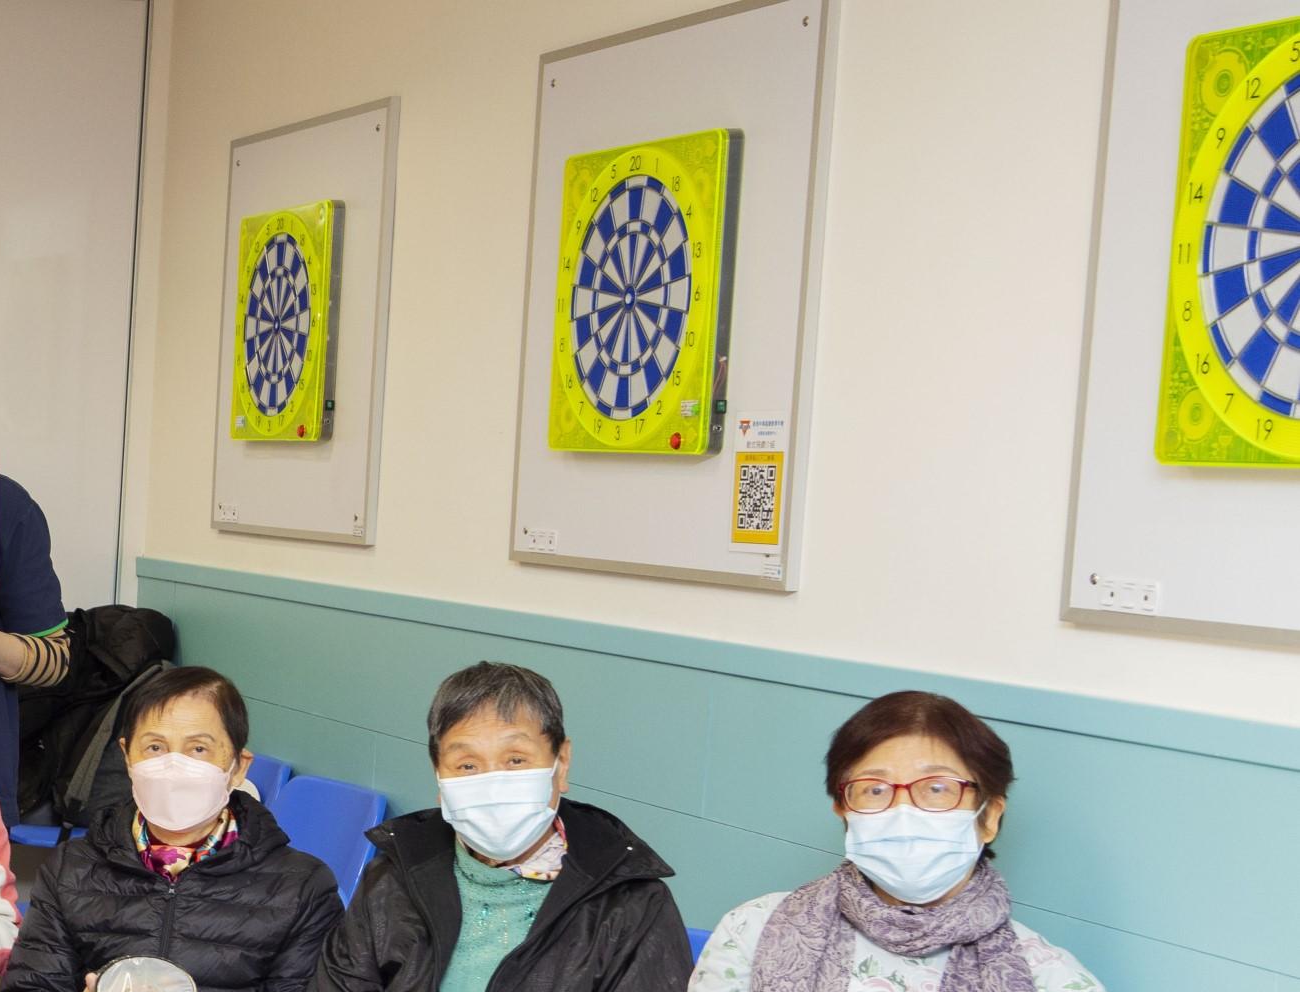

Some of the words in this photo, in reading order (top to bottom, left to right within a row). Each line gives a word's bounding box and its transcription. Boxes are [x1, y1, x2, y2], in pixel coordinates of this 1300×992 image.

[1246, 77, 1261, 100] 12
[1216, 128, 1226, 149] 9
[610, 164, 617, 179] 5
[629, 155, 641, 172] 20
[671, 176, 680, 192] 18
[590, 187, 599, 202] 12
[1189, 182, 1202, 204] 14
[685, 203, 692, 219] 4
[576, 220, 582, 234] 9
[692, 241, 702, 258] 13
[1178, 243, 1191, 264] 11
[563, 256, 571, 272] 14
[694, 283, 700, 302] 6
[557, 298, 565, 314] 11
[1182, 301, 1192, 321] 8
[685, 331, 696, 347] 10
[1197, 353, 1210, 374] 16
[565, 374, 573, 389] 16
[672, 371, 681, 387] 15
[579, 401, 584, 416] 7
[656, 400, 663, 415] 2
[1224, 393, 1234, 414] 7
[593, 418, 602, 434] 19
[615, 425, 621, 441] 3
[635, 418, 645, 435] 17
[1256, 419, 1273, 440] 19
